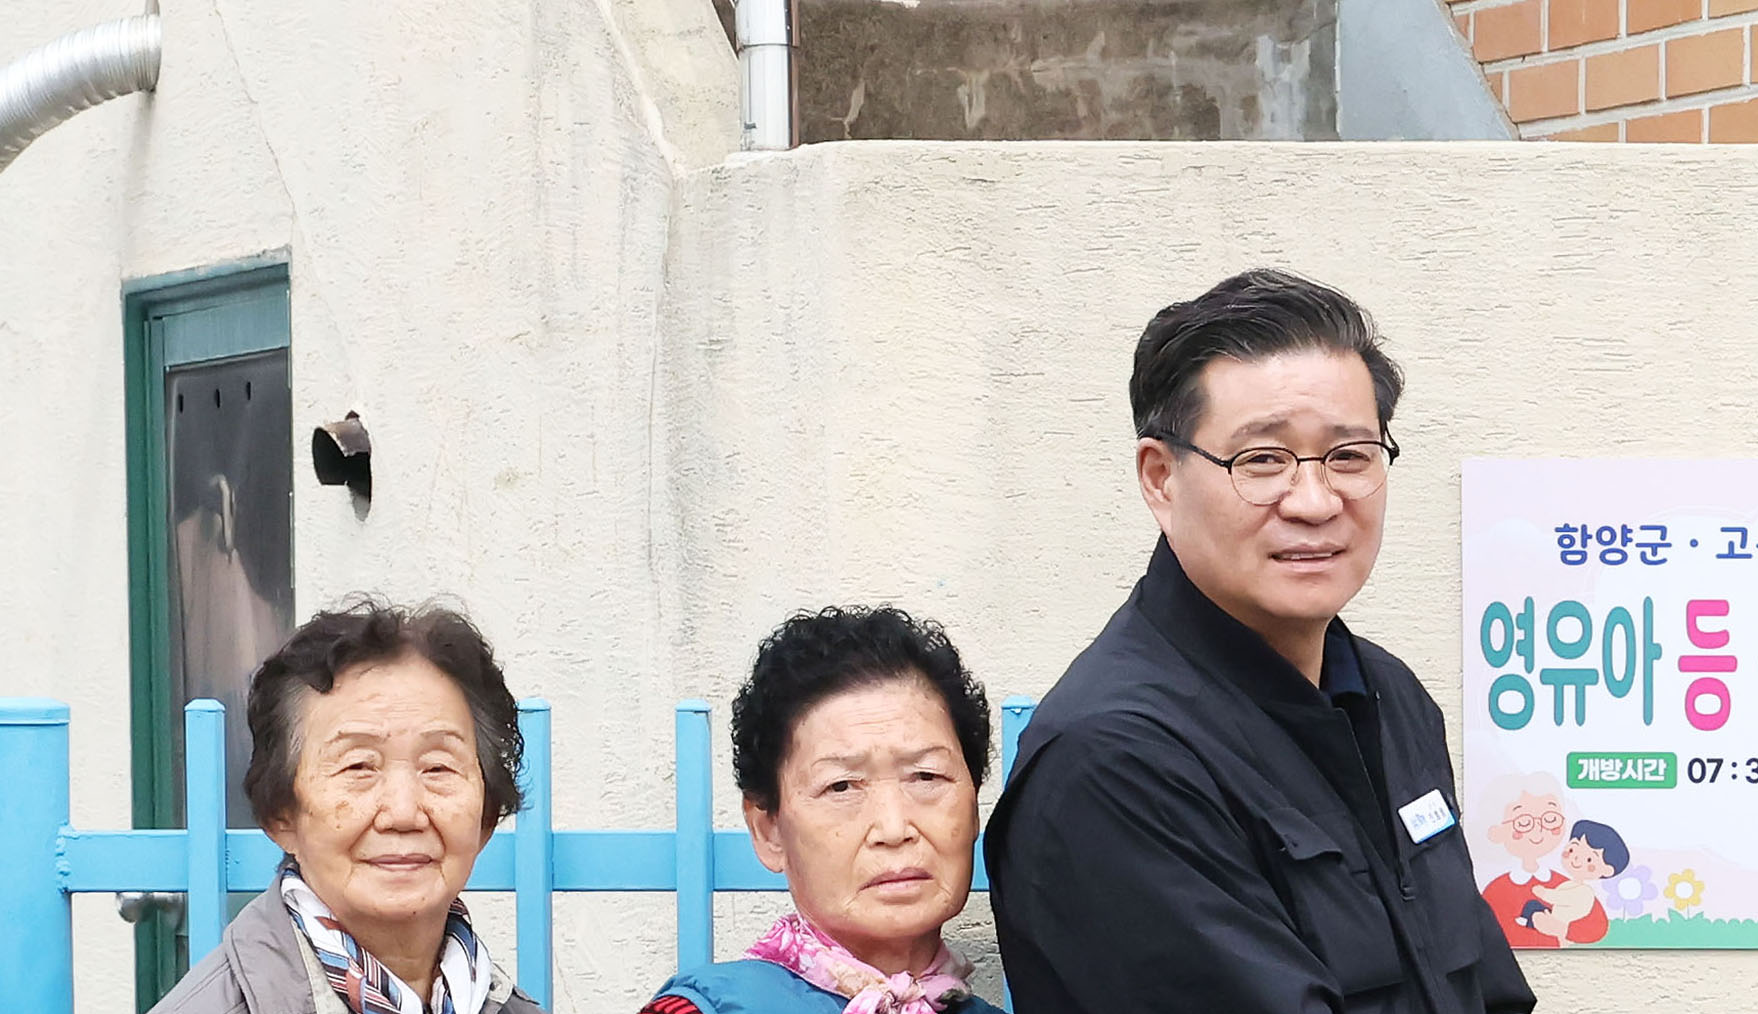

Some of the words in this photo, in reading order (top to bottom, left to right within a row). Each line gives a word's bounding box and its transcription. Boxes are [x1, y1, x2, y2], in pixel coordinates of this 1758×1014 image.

[1554, 522, 1673, 567] 함양군
[1480, 595, 1663, 732] 영유아
[1577, 757, 1668, 782] 개방시간
